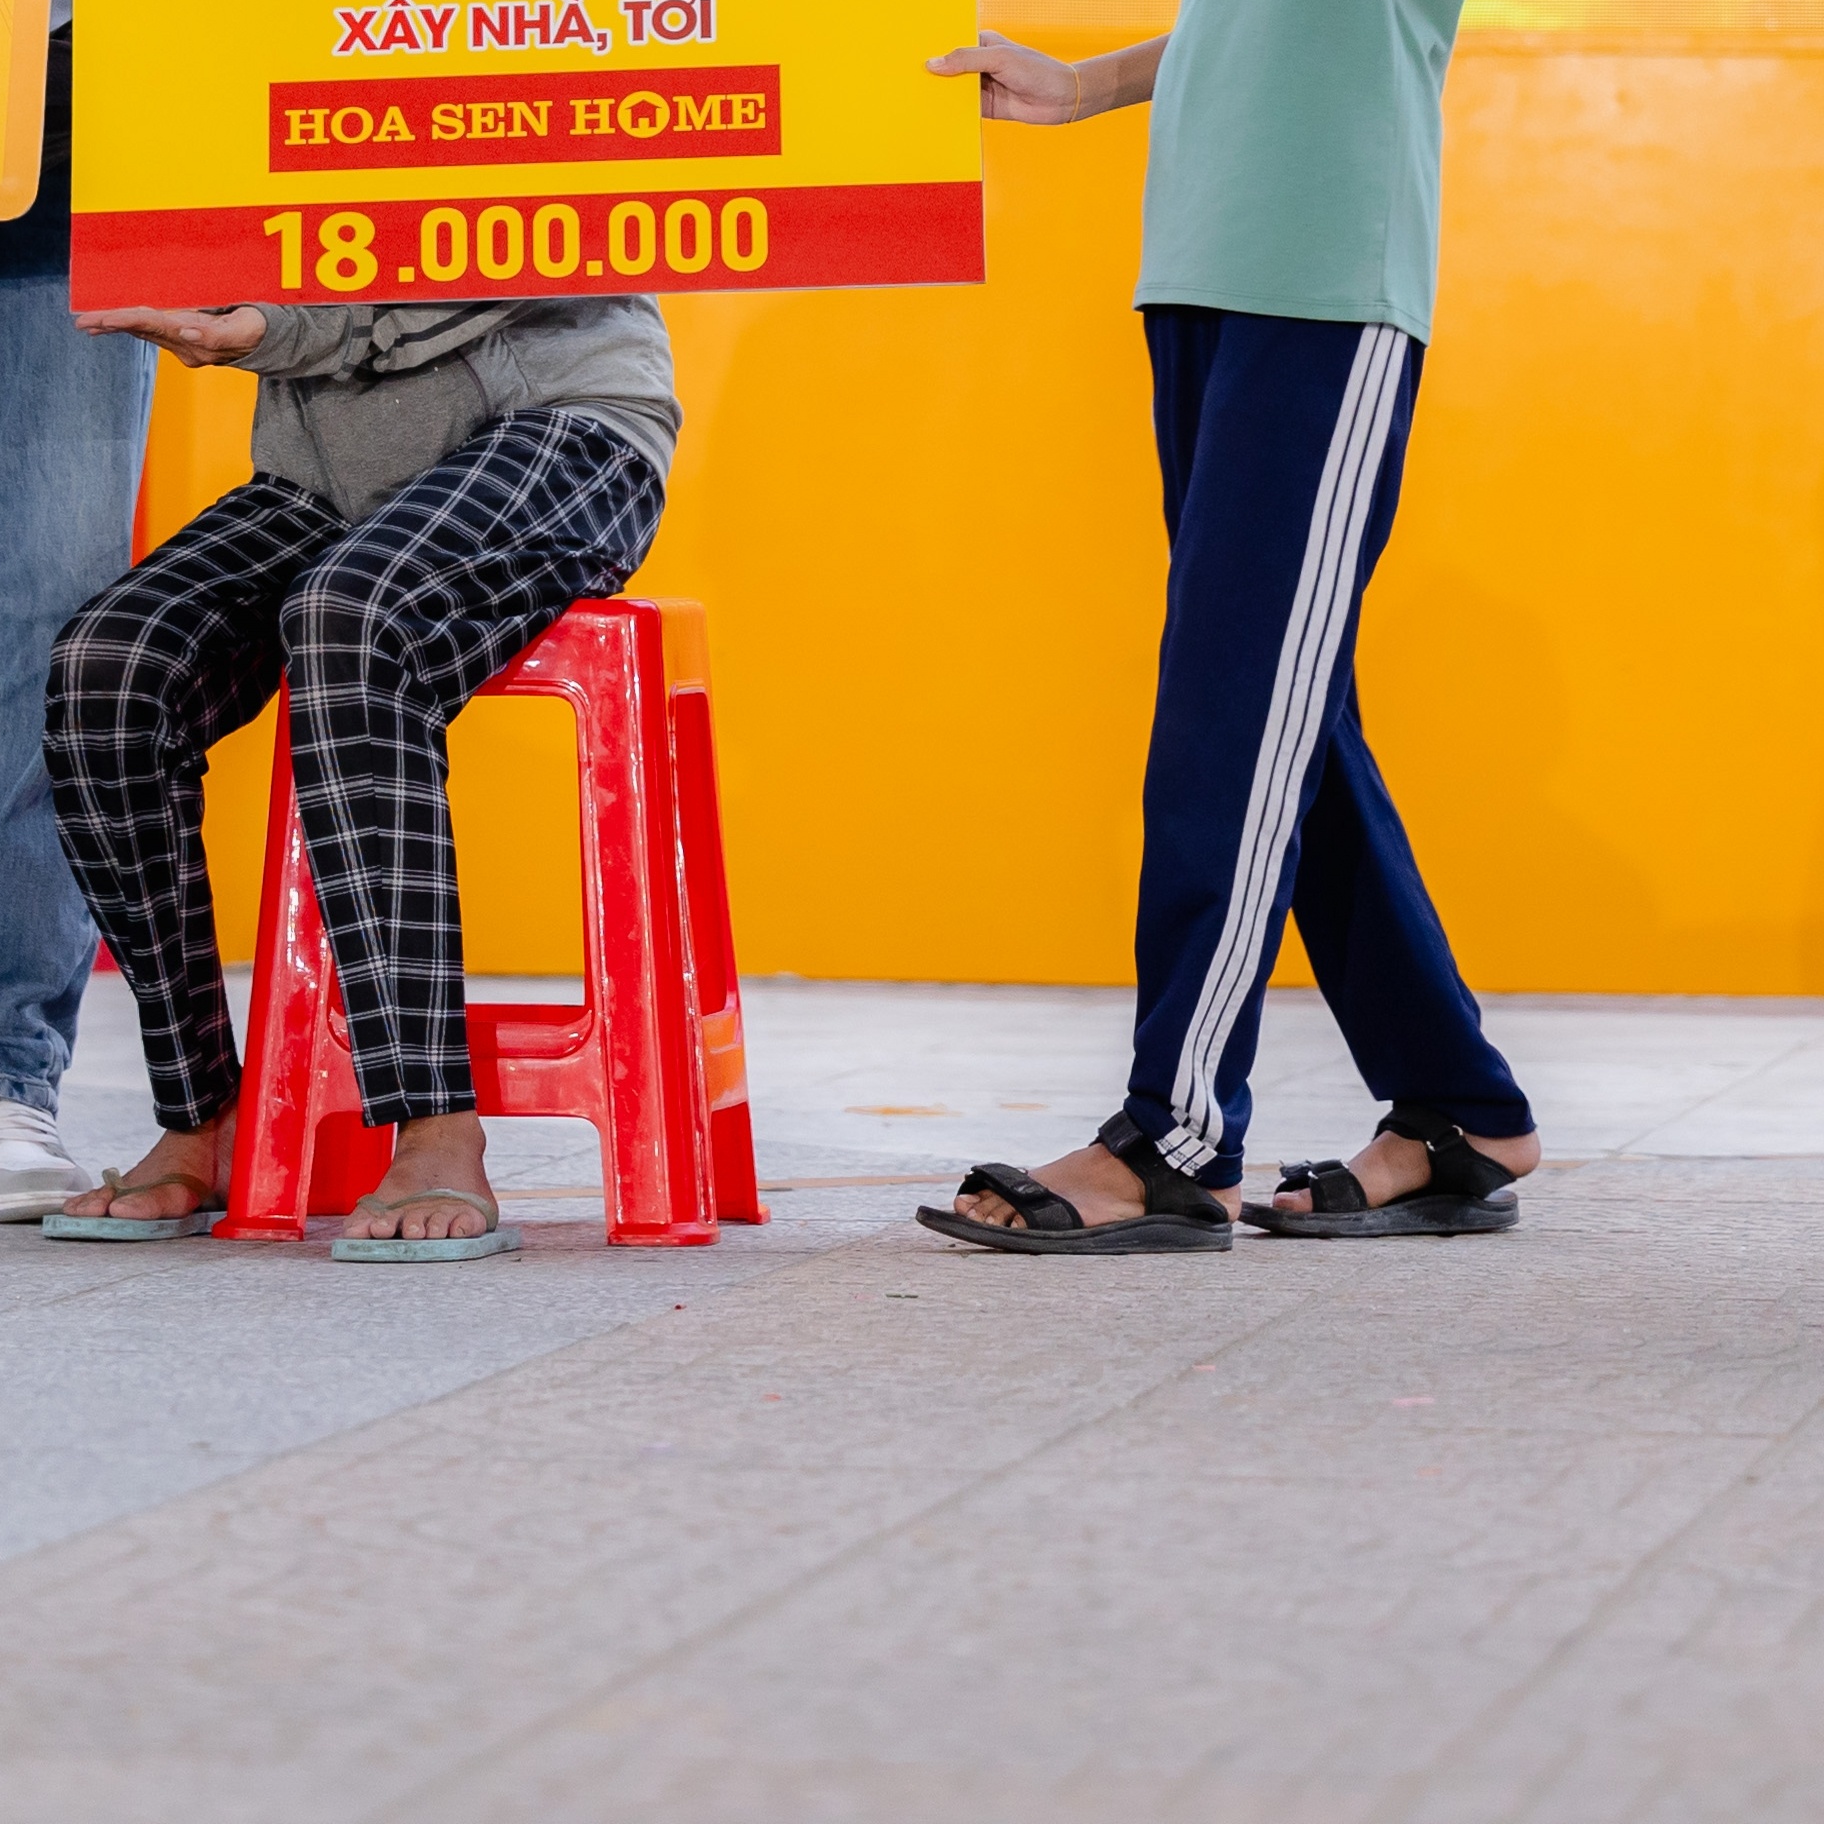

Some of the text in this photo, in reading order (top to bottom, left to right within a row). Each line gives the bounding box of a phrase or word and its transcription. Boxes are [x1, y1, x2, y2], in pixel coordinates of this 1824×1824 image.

[284, 90, 767, 146] HOA SEN HOME
